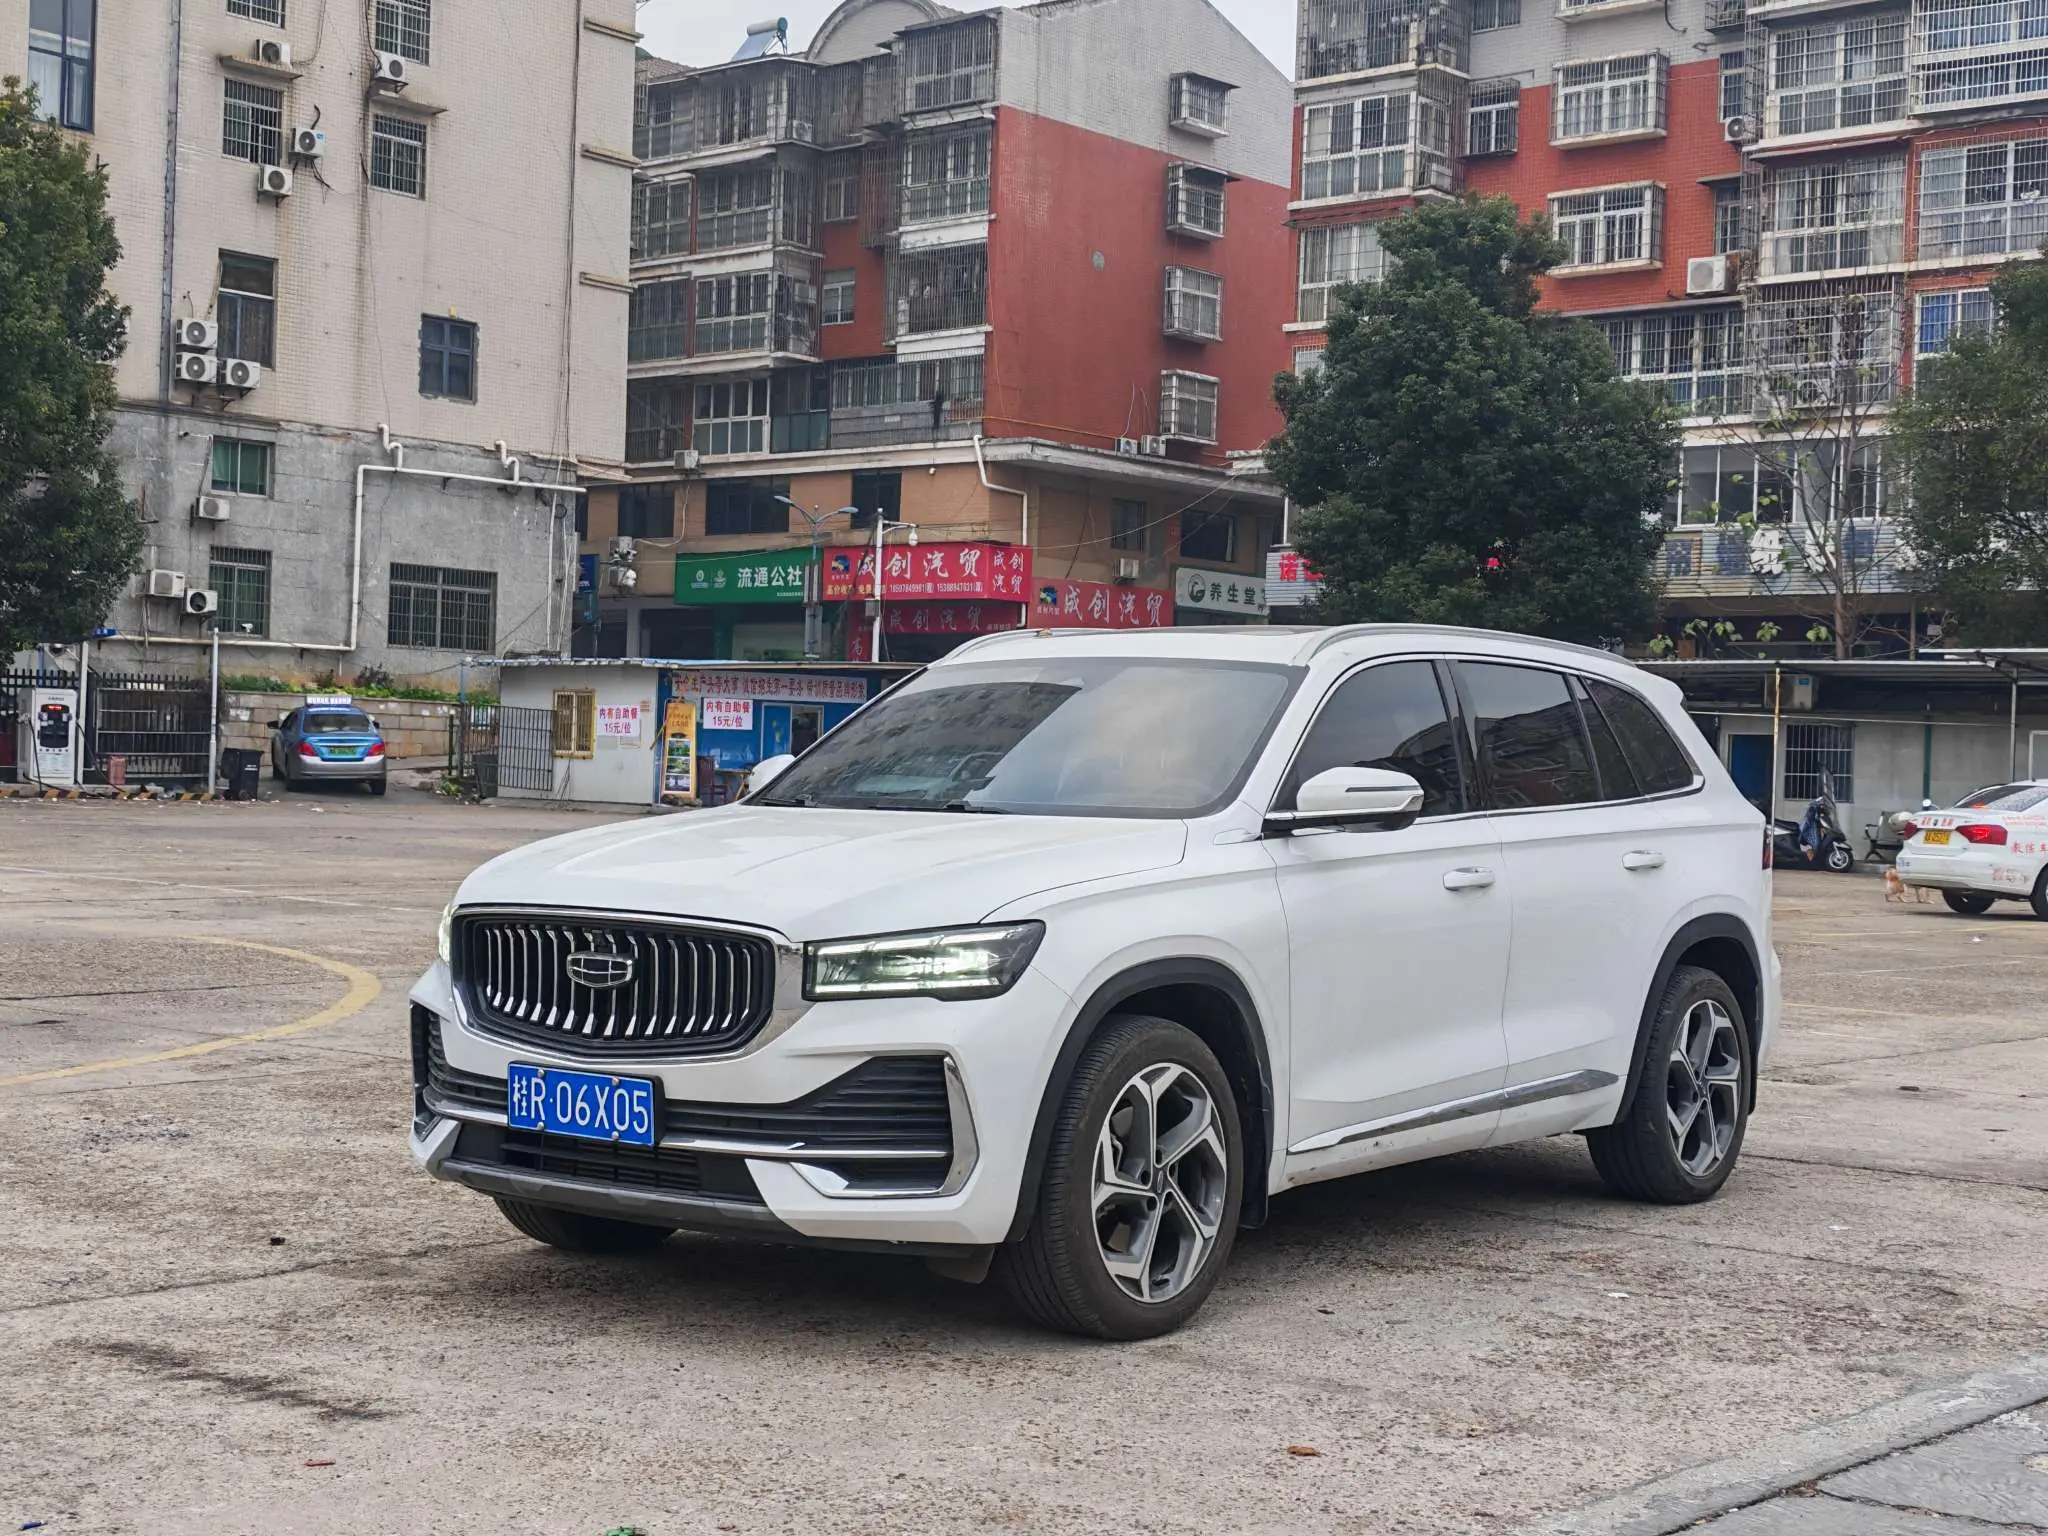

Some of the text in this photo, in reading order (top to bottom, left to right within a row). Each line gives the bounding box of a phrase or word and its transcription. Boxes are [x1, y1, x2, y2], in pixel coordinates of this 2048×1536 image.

[737, 565, 803, 588] 流通公社
[1064, 584, 1163, 626] 成创汽贸
[600, 707, 638, 720] 内有自助餐
[706, 701, 750, 714] 内有自助餐
[712, 714, 743, 728] 15元/位
[604, 722, 632, 734] 15元/位
